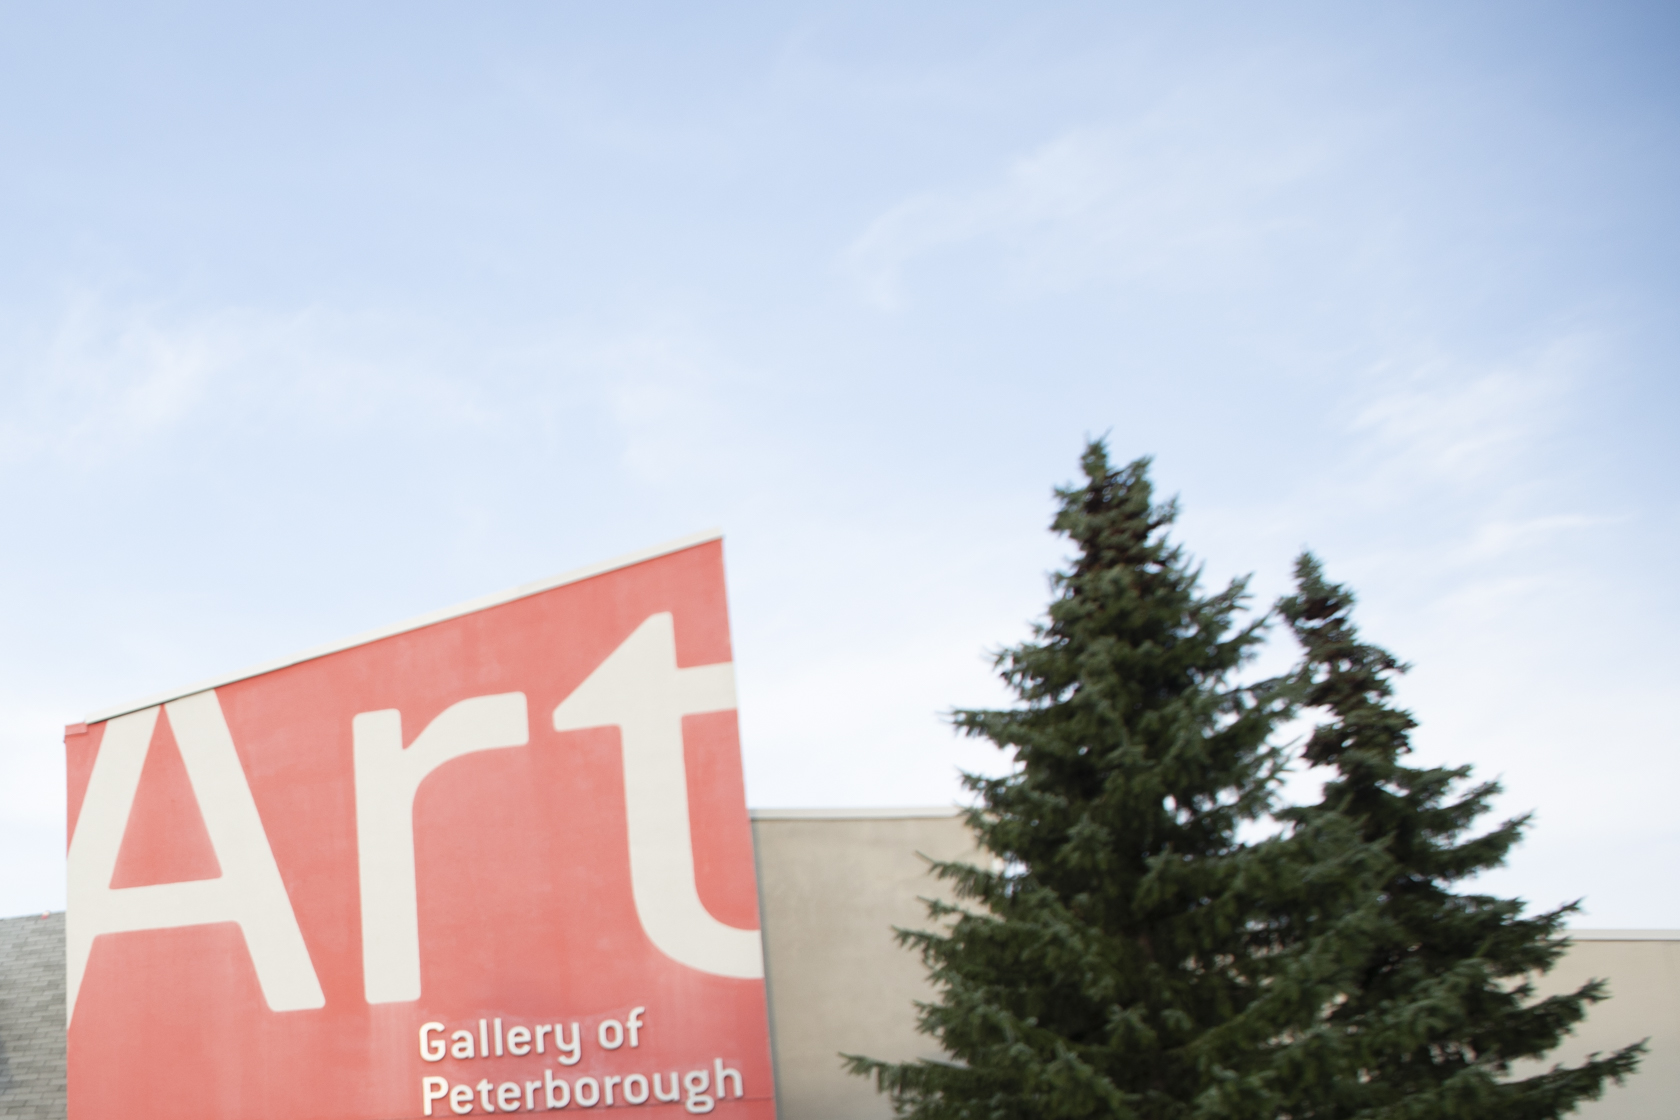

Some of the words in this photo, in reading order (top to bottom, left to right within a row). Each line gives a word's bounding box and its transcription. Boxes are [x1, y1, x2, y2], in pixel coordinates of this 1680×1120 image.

[67, 611, 764, 1030] Art
[419, 1021, 582, 1066] Gallery
[598, 1006, 646, 1050] of
[422, 1057, 745, 1115] Peterborough
